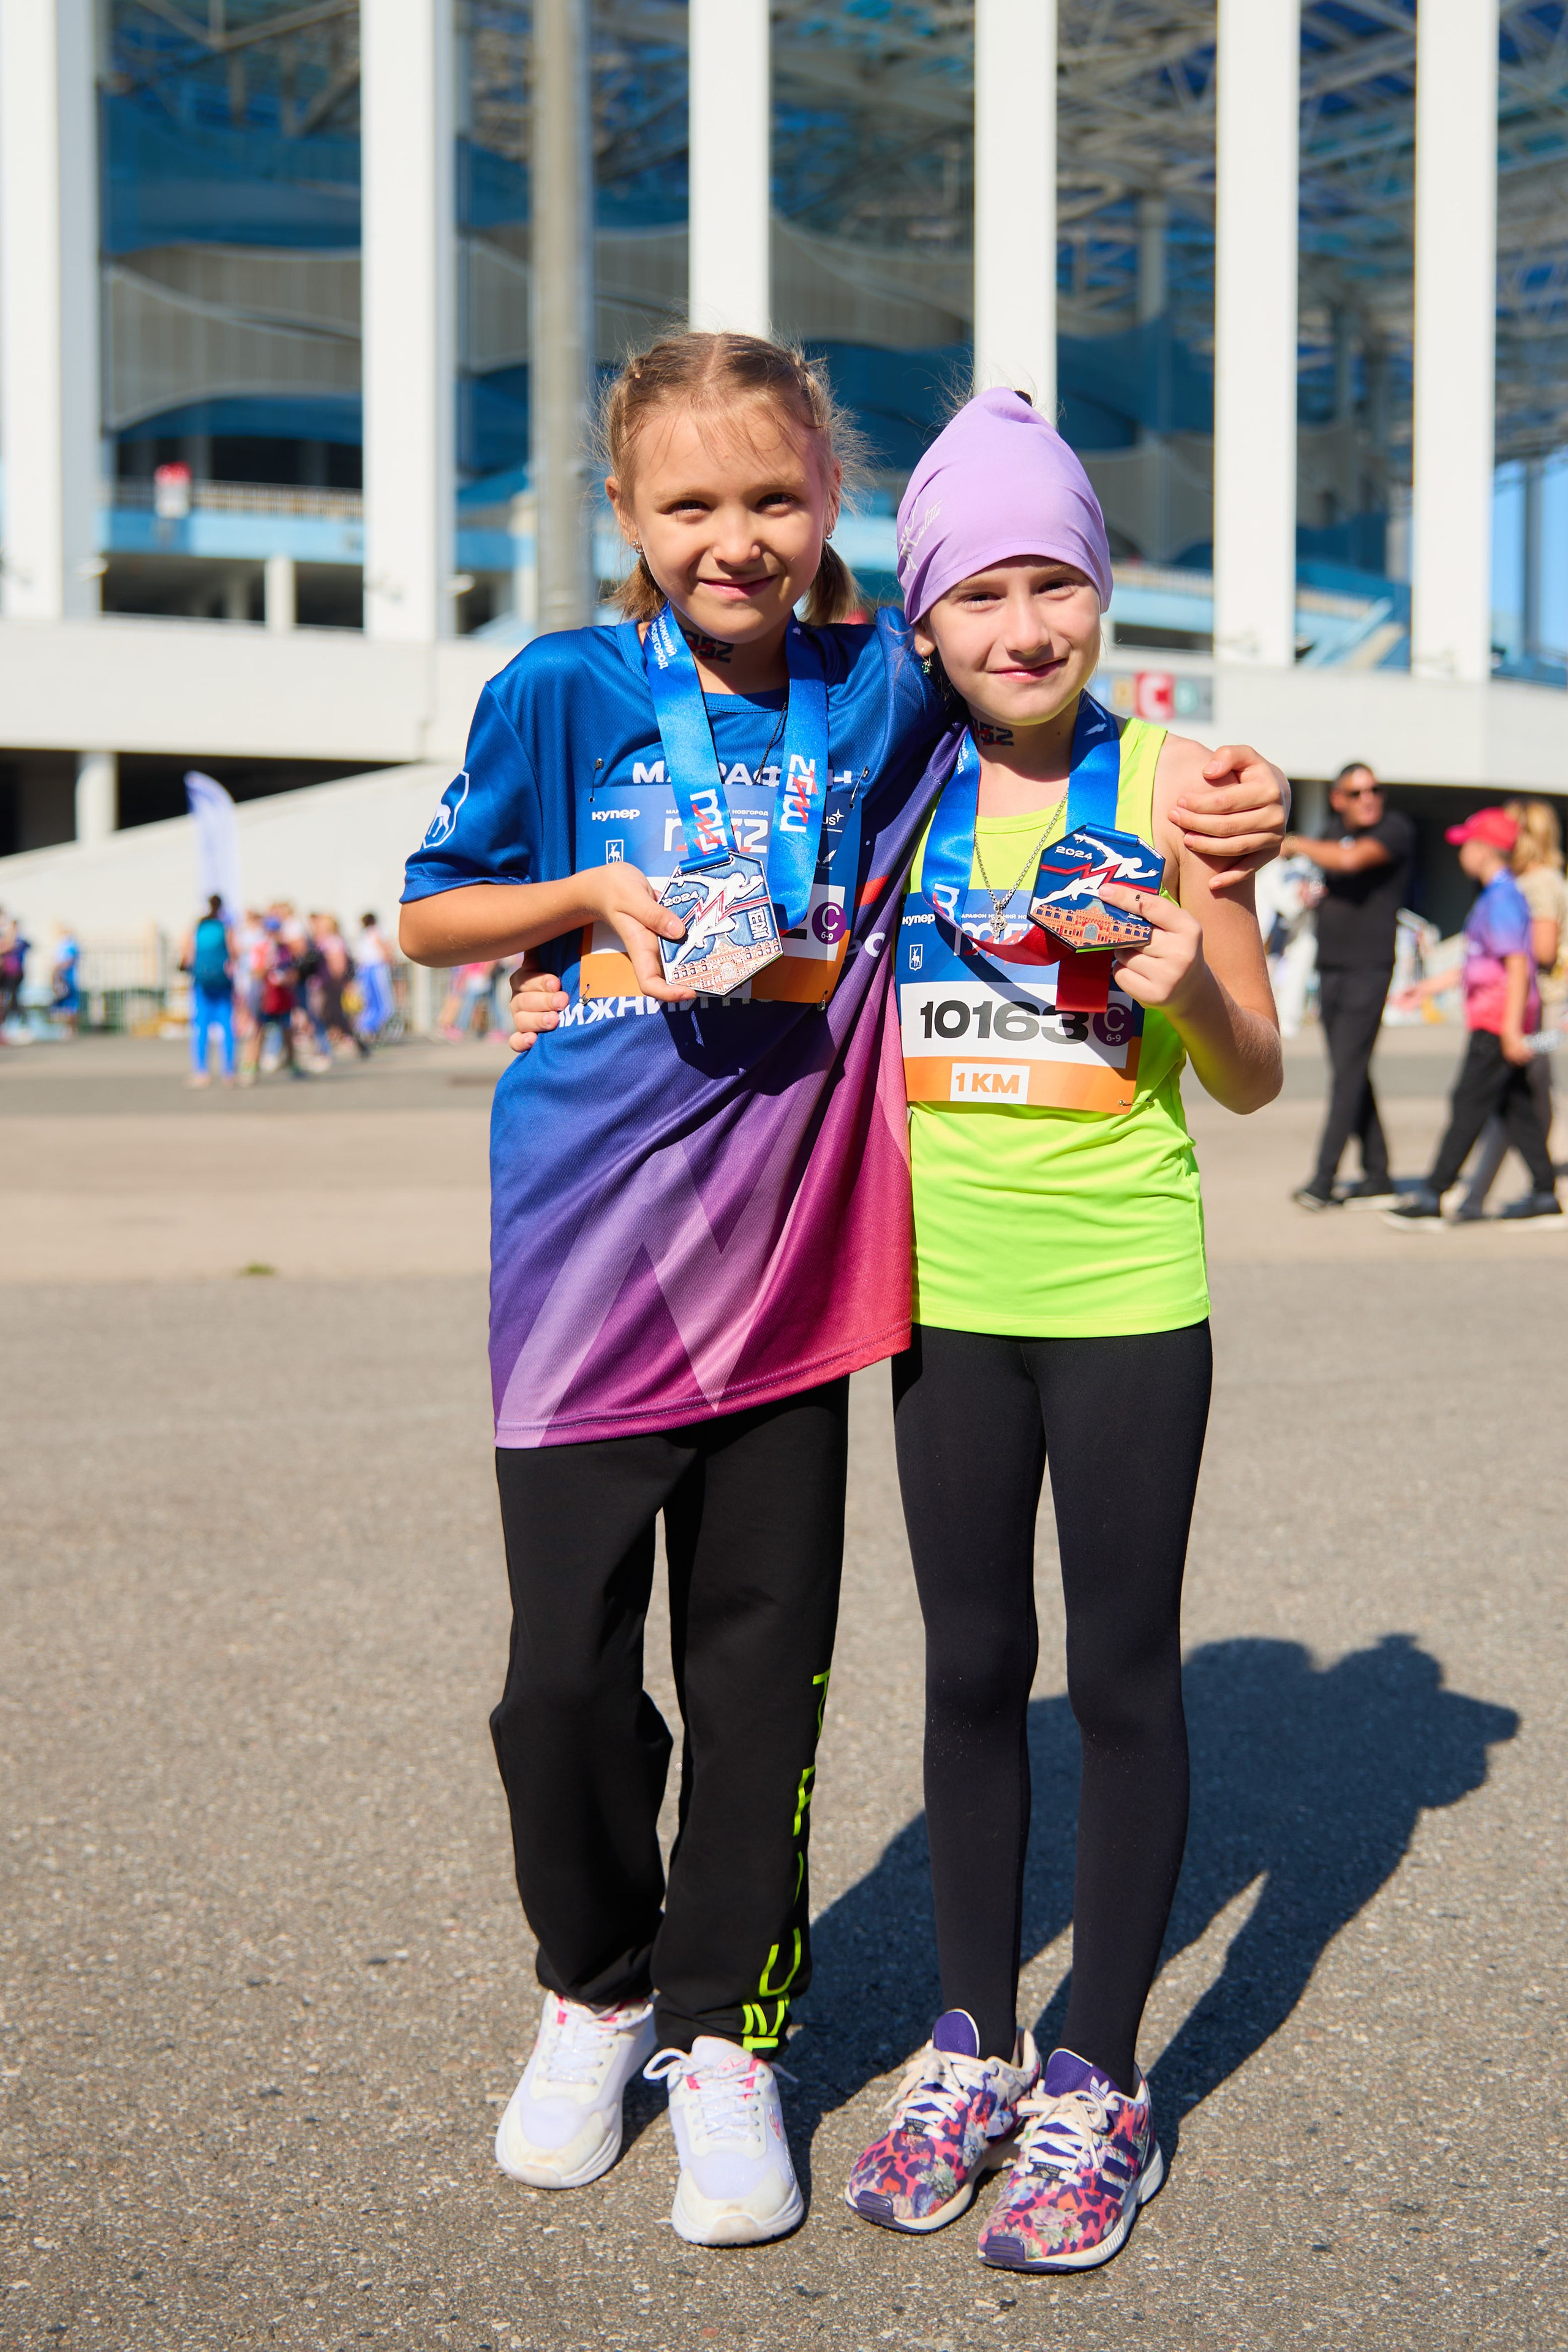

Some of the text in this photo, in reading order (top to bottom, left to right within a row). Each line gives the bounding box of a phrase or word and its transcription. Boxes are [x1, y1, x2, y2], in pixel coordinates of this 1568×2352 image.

[658, 616, 678, 657] НИЖНИЙ
[651, 622, 669, 669] НОВГОРОД
[592, 809, 641, 821] купер
[1055, 846, 1093, 860] 2024
[662, 890, 700, 907] 2024
[902, 913, 936, 926] купер
[821, 932, 834, 941] 6-9
[920, 1000, 1089, 1045] 10163
[956, 1072, 965, 1092] 1
